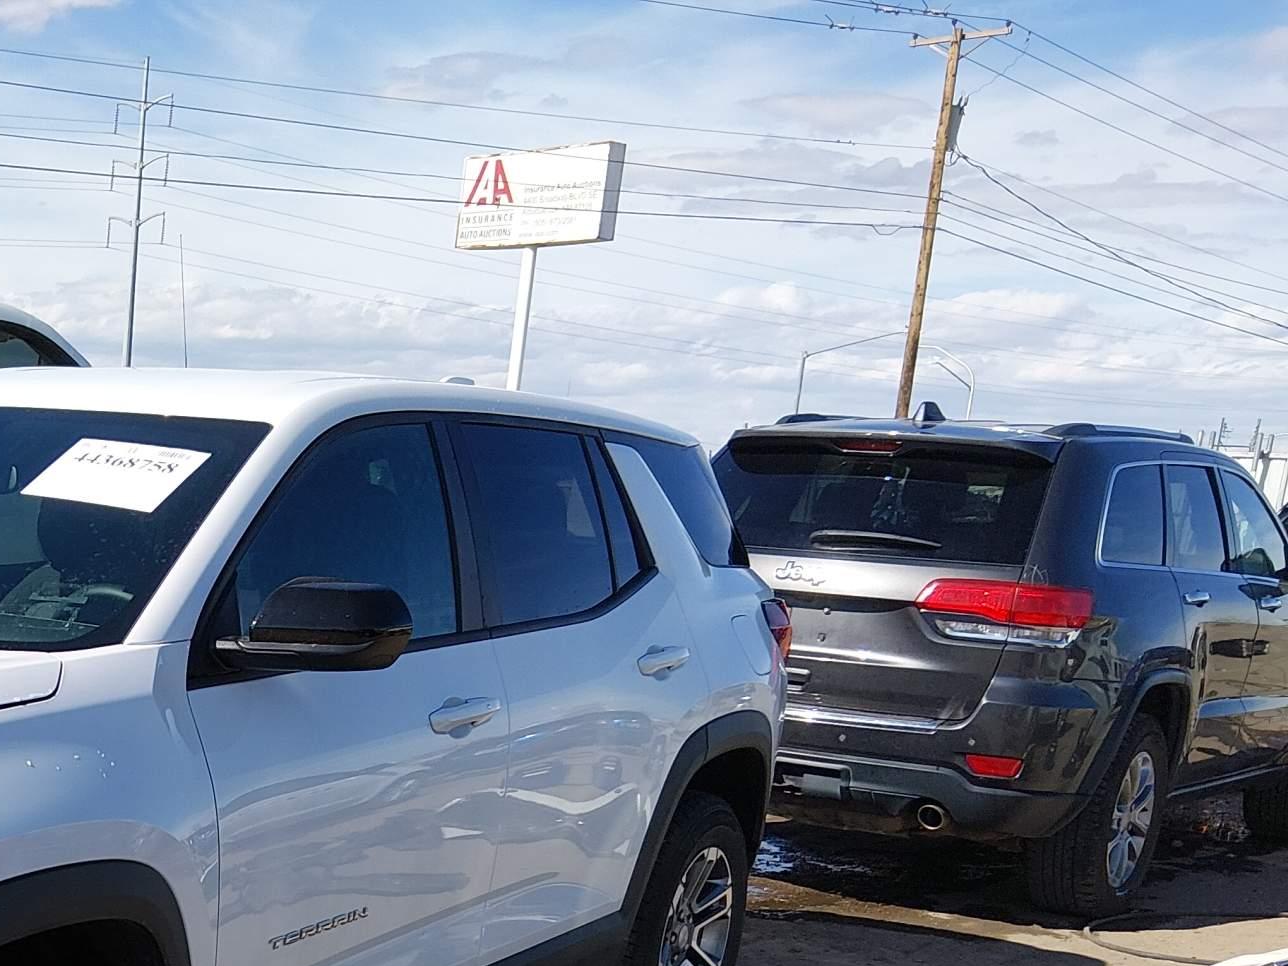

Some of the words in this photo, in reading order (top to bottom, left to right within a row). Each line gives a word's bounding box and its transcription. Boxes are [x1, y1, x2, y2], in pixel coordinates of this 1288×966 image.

[461, 213, 513, 226] INSURANCE
[460, 230, 478, 240] AUTO
[479, 228, 511, 239] AUCTIONS
[74, 452, 180, 474] 44368758
[268, 906, 368, 950] TERRAIN
